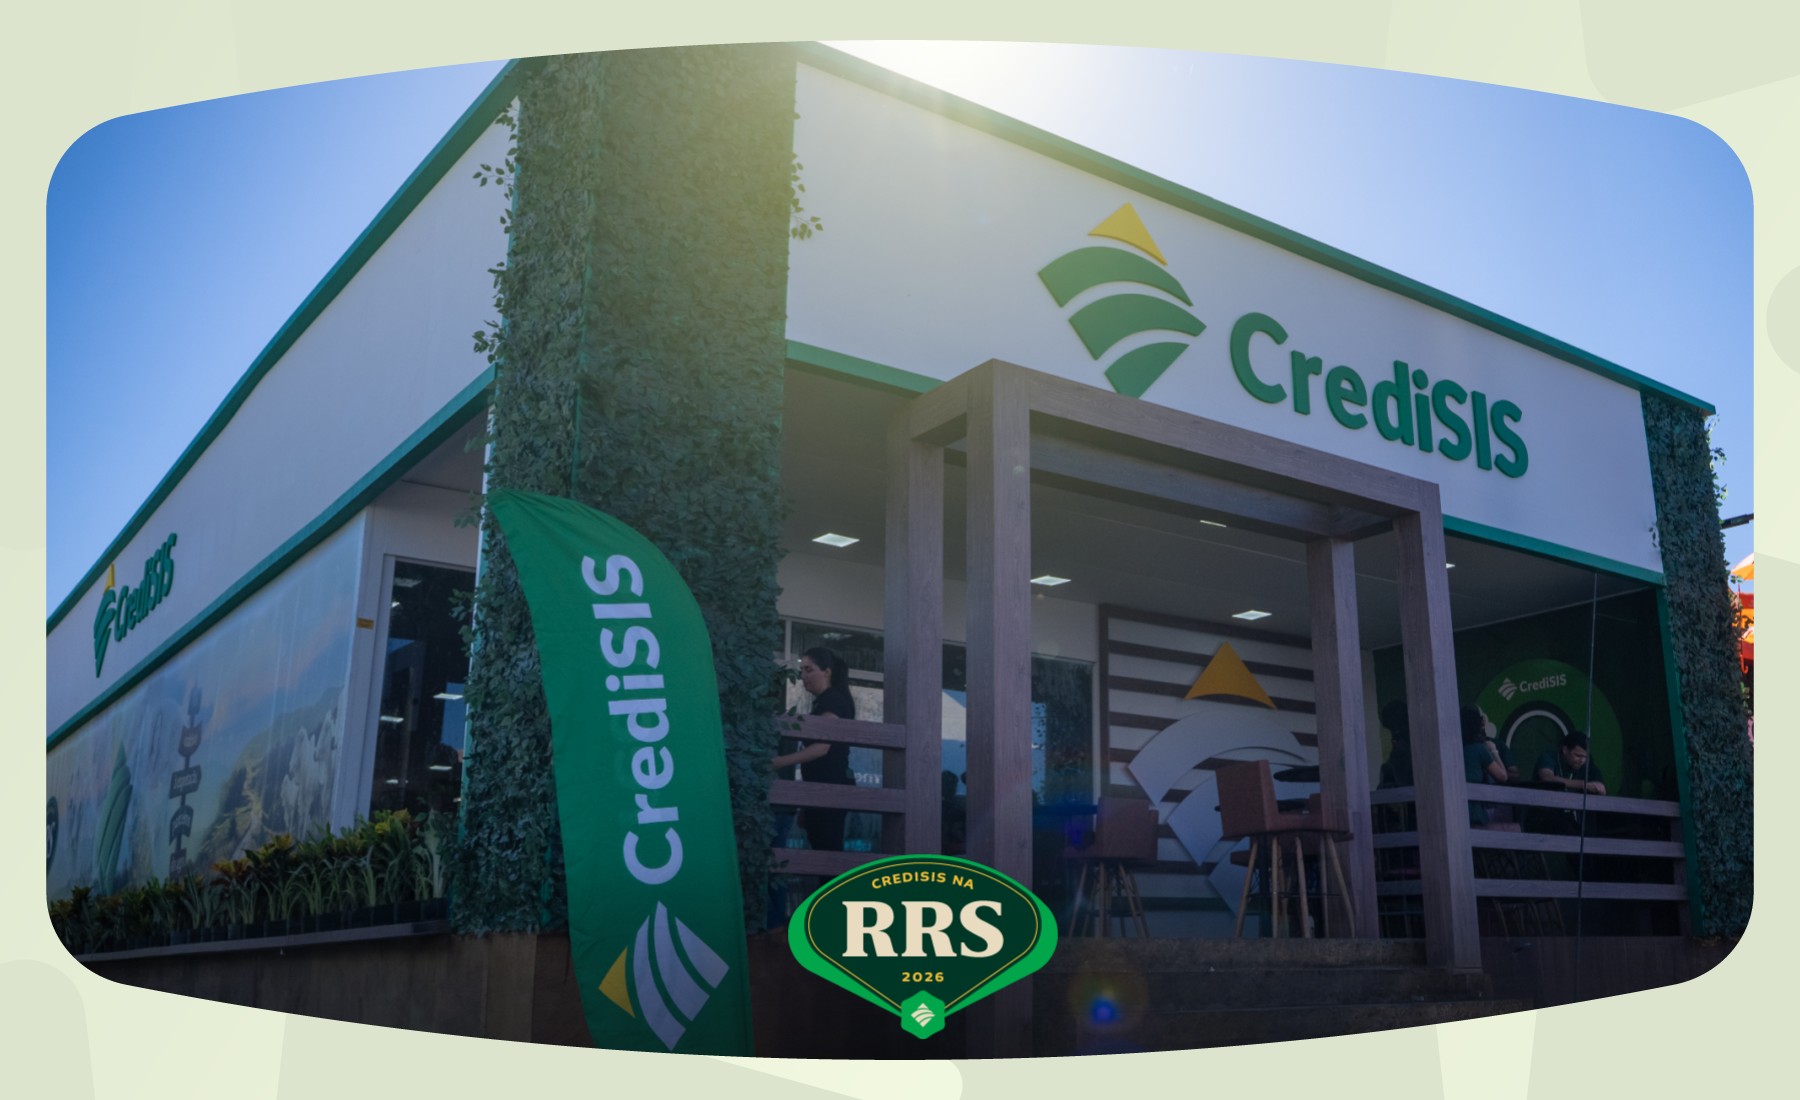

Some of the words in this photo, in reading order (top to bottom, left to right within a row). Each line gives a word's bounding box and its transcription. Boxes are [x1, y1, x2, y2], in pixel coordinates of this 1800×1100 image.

[1230, 312, 1529, 478] CrediSIS
[114, 532, 177, 642] CrediSIS
[581, 553, 684, 885] CrediSIS
[1519, 673, 1567, 693] CrediSIS
